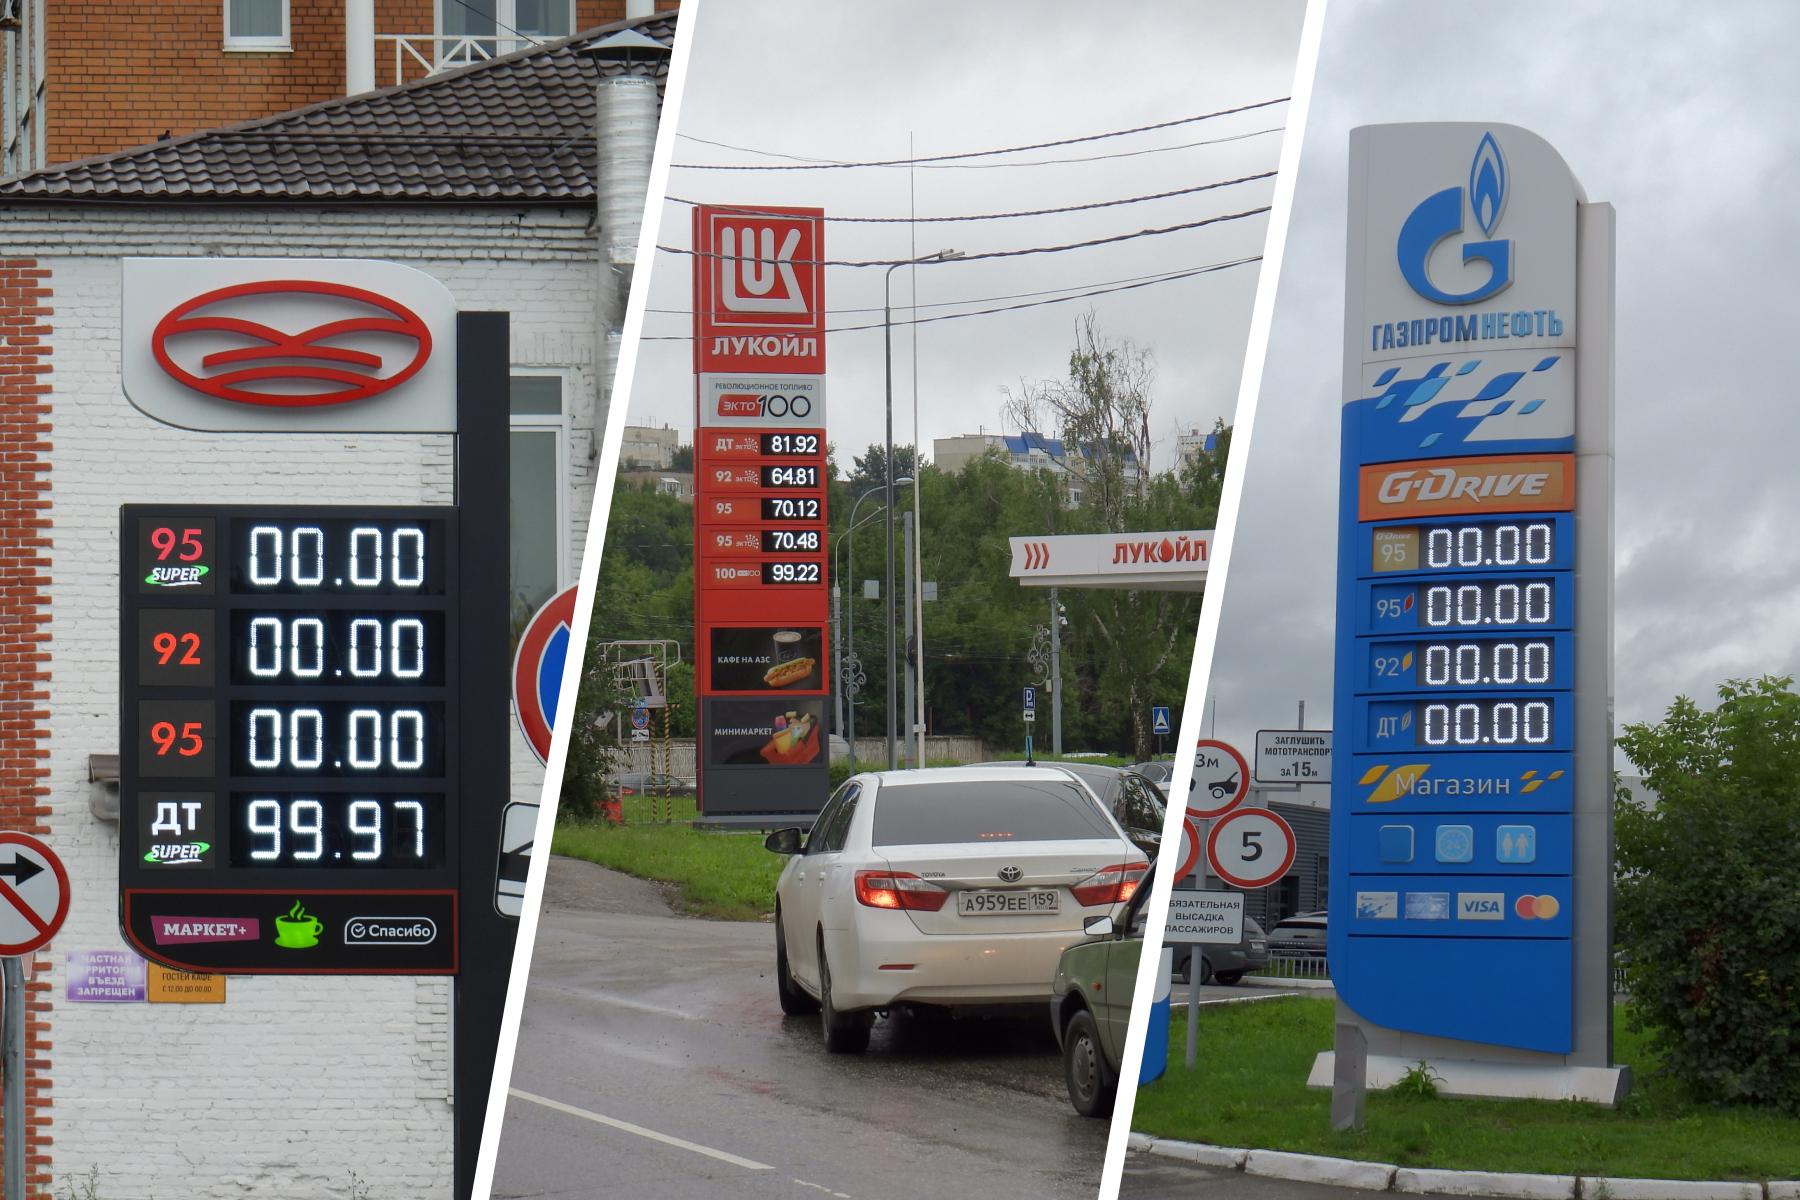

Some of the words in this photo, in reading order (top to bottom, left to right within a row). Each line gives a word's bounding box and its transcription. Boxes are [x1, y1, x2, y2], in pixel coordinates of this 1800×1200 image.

[1372, 310, 1564, 352] ГАЗПРОМНЕФТЬ
[712, 333, 817, 357] ЛУКОЙЛ
[716, 438, 734, 451] ДТ
[771, 435, 817, 453] 81.92
[716, 471, 732, 482] 92
[771, 468, 814, 485] 64.81
[716, 503, 732, 514] 95
[772, 500, 818, 517] 70.12
[716, 535, 733, 546] 95
[772, 532, 818, 549] 70.48
[1381, 544, 1406, 563] 95
[1428, 524, 1550, 568] 00.00
[151, 527, 203, 561] 95
[249, 525, 425, 587] 00.00
[152, 567, 200, 581] SUPER
[715, 568, 736, 579] 100
[773, 564, 819, 581] 99.22
[1376, 600, 1401, 618] 95
[1427, 583, 1550, 626] 00.00
[153, 632, 201, 665] 92
[249, 617, 425, 678] 00.00
[717, 656, 740, 664] КАФЕ
[742, 656, 753, 664] НА
[755, 656, 771, 664] АЗС
[1375, 658, 1399, 676] 92
[1425, 643, 1549, 685] 00.00
[714, 728, 772, 736] МИНИМАРКЕТ
[1376, 718, 1398, 738] ДТ
[1425, 702, 1549, 745] 00.00
[151, 721, 203, 757] 95
[249, 708, 424, 769] 00.00
[1275, 736, 1325, 745] ЗАГЛУШИТЬ
[1265, 747, 1333, 756] МОТОТРАНСПОР
[1395, 774, 1510, 795] Магазин
[152, 802, 201, 835] ДТ
[248, 800, 424, 860] 99.97
[151, 844, 200, 859] SUPER
[1241, 831, 1263, 861] 5
[1169, 900, 1240, 909] БЯЗАТЕЛЬНАЯ
[1464, 901, 1500, 913] VISA
[1175, 913, 1224, 922] ВЫСАДКА
[164, 923, 247, 936] МАРКЕТ+
[369, 924, 431, 937] Спасибо
[1165, 925, 1234, 934] ПАССАЖИРОВ
[88, 976, 125, 986] ВЪЕЗД
[77, 987, 136, 997] ЗАПРЕЩЕН
